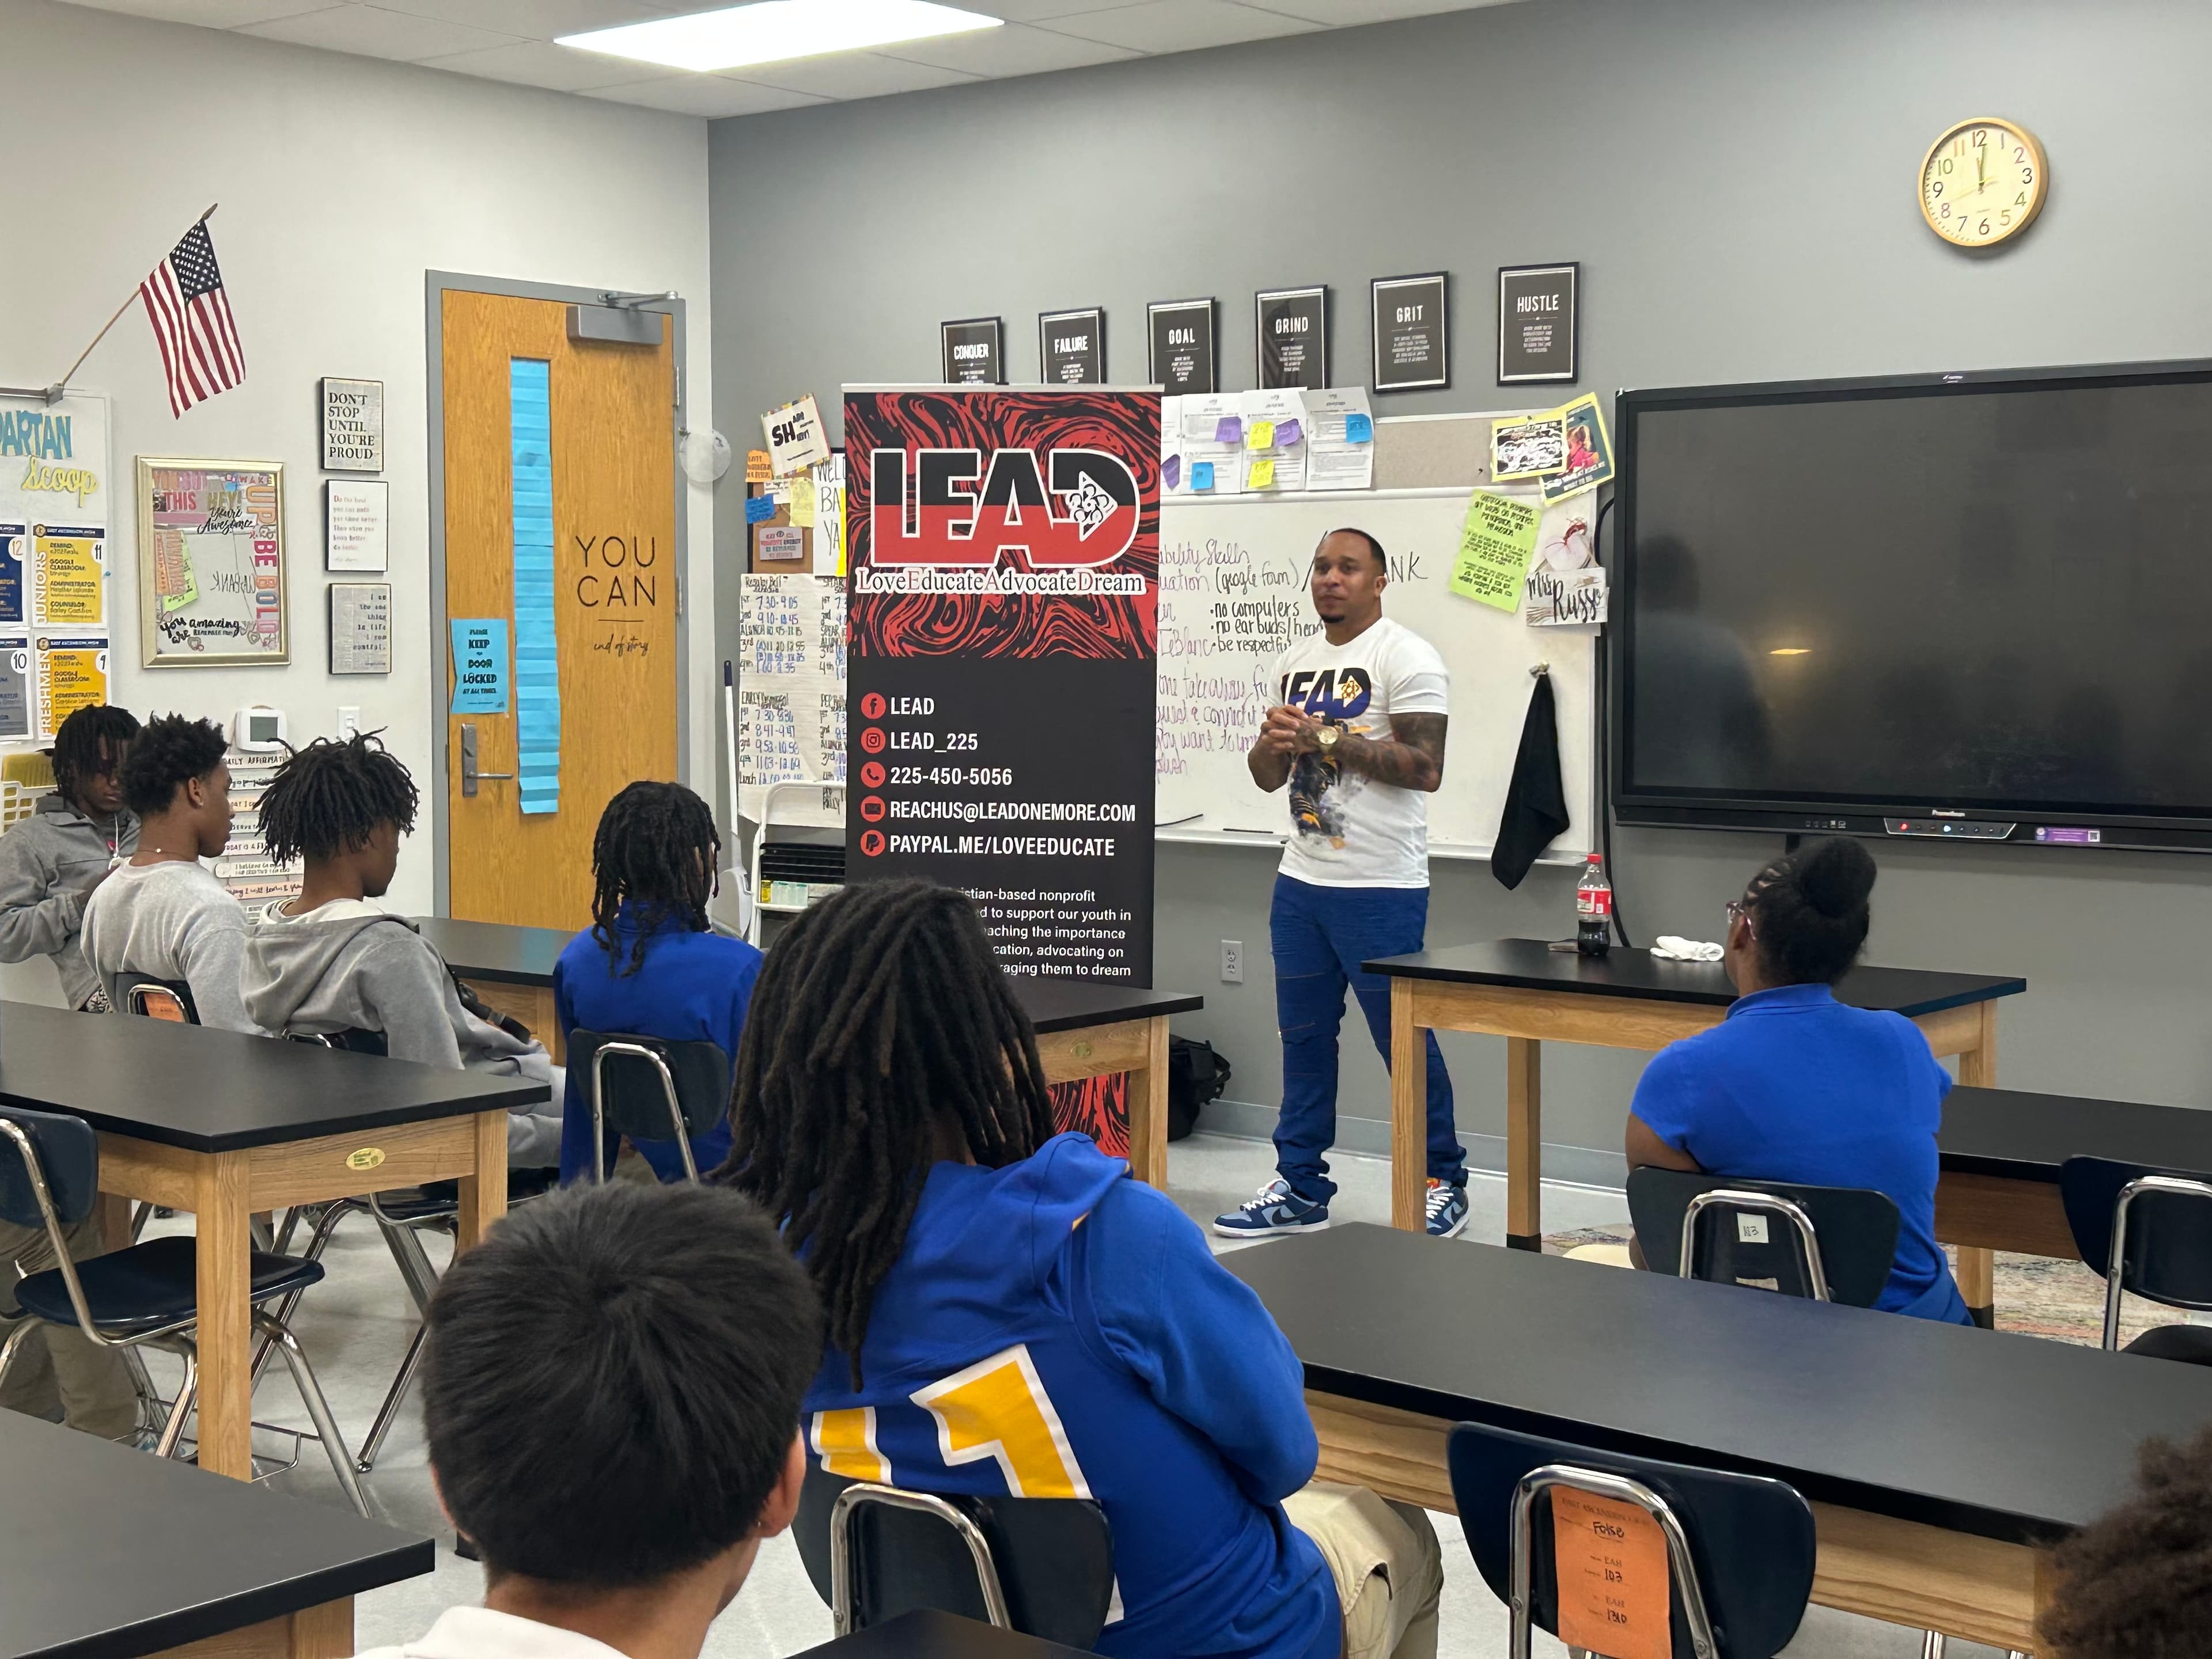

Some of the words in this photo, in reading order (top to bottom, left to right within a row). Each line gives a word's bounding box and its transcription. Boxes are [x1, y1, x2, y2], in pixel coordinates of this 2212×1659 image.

[1972, 130, 1987, 147] 12
[2001, 132, 2004, 149] 1
[1954, 139, 1965, 157] 11
[2013, 147, 2025, 164] 2
[1938, 158, 1953, 176] 10
[2022, 168, 2032, 184] 3
[1933, 181, 1944, 198] 9
[2014, 191, 2027, 206] 4
[1941, 203, 1951, 218] 8
[2000, 210, 2010, 226] 5
[1958, 216, 1968, 232] 7
[1979, 218, 1990, 235] 6
[1517, 294, 1559, 312] HUSTLE
[1396, 305, 1423, 322] GRIT
[1275, 316, 1308, 334] GRIND
[1054, 335, 1088, 354] FAILURE
[1168, 328, 1195, 345] GOAL
[953, 343, 989, 361] CONQUER
[328, 406, 360, 418] STOP
[329, 419, 367, 432] UNTIL
[0, 410, 72, 460] ARTAN
[329, 433, 375, 446] YOU'RE
[329, 447, 373, 459] PROUD
[163, 491, 196, 510] THIS
[870, 448, 1141, 568] LEAD
[13, 540, 24, 556] 12
[95, 544, 102, 560] 11
[254, 540, 278, 567] BE
[575, 536, 655, 567] YOU
[1386, 551, 1429, 583] NK
[36, 551, 47, 623] JUNIORS
[858, 570, 1143, 592] LoveEducateAdvocateDream
[1158, 569, 1210, 591] uation
[577, 575, 656, 607] CAN
[256, 575, 279, 633] BOLD
[594, 634, 614, 653] end
[615, 635, 624, 657] of
[627, 636, 649, 656] story
[13, 653, 27, 669] 10
[100, 654, 106, 670] 9
[40, 650, 52, 737] FRESHMEN
[891, 697, 934, 715] LEAD
[891, 732, 978, 753] LEAD_225
[891, 767, 1013, 786] 225-450-5056
[891, 801, 1136, 823] REACHUS@LEADONEMORE.COM
[891, 835, 1115, 857] PAYPAL.ME/LOVEEDUCATE
[960, 888, 1036, 900] istian-based
[1039, 890, 1096, 903] nonprofit
[991, 907, 1003, 918] to
[1006, 908, 1054, 921] support
[1058, 911, 1079, 920] our
[1081, 910, 1116, 923] youth
[1120, 908, 1131, 921] in
[984, 925, 1028, 939] aching
[1032, 925, 1051, 937] the
[1055, 926, 1126, 941] importance
[993, 944, 1033, 957] cation,
[1037, 944, 1104, 960] advocating
[1108, 947, 1124, 957] on
[1041, 962, 1073, 975] them
[1076, 963, 1088, 975] to
[1092, 963, 1131, 976] dream
[1605, 1568, 1623, 1583] 103
